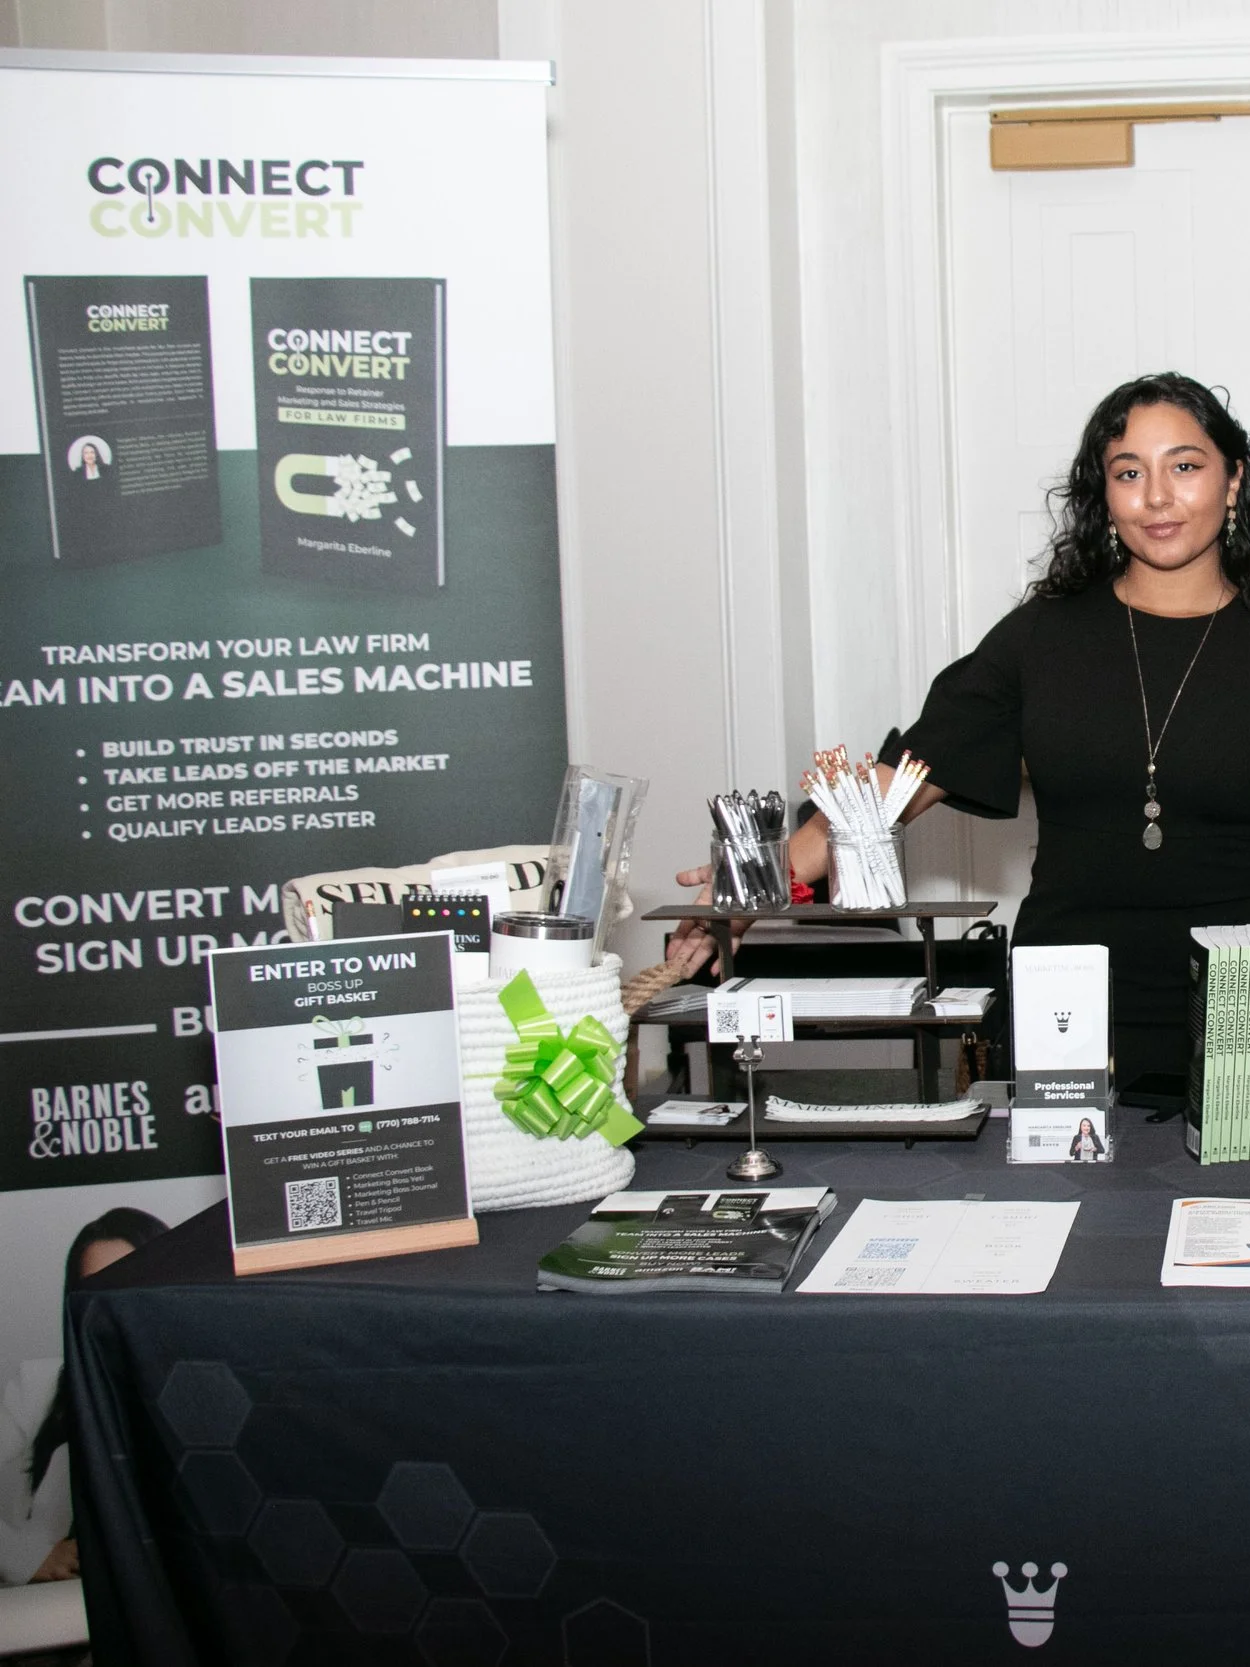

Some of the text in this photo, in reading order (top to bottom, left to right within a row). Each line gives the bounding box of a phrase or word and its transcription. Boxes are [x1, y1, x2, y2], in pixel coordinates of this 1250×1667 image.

[88, 156, 364, 197] CONNECT
[89, 199, 363, 240] CONVERT
[87, 304, 170, 319] CONNECT
[88, 317, 170, 332] CONVERT
[268, 329, 412, 355] CONNECT
[269, 352, 411, 380] CONVERT
[286, 410, 398, 426] FOR LAW FIRMS
[298, 537, 392, 558] Margarita Eberline
[42, 633, 429, 665] TRANSFORM YOUR LAW FIRM
[79, 674, 173, 704] INTO
[184, 671, 215, 700] A
[223, 667, 343, 698] SALES
[354, 660, 533, 693] MACHINE
[103, 729, 399, 758] BUILD TRUST IN SECONDS
[104, 754, 450, 786] TAKE LEADS OFF THE MARKET
[107, 784, 359, 813] GET MORE REFERRALS
[108, 810, 376, 841] QUALIFY LEADS FASTER
[14, 886, 229, 928] CONVERT
[36, 938, 143, 974] SIGN
[156, 934, 218, 966] UP
[250, 952, 417, 982] ENTER TO WIN
[295, 991, 378, 1008] GIFT BASKET
[308, 978, 363, 993] BOSS UP
[1206, 964, 1217, 1060] CONNECT CONVERT
[31, 1080, 149, 1122] BARNES
[1034, 1081, 1095, 1092] Professional
[1044, 1091, 1086, 1100] Services
[254, 1115, 440, 1142] TEXT YOUR EMAIL TO (770) 788-7114
[264, 1157, 279, 1165] GET
[288, 1153, 308, 1162] FREE
[310, 1150, 334, 1159] VIDEO
[336, 1148, 364, 1158] SERIES
[365, 1144, 383, 1153] AND
[390, 1141, 422, 1150] CHANCE
[423, 1139, 435, 1147] TO
